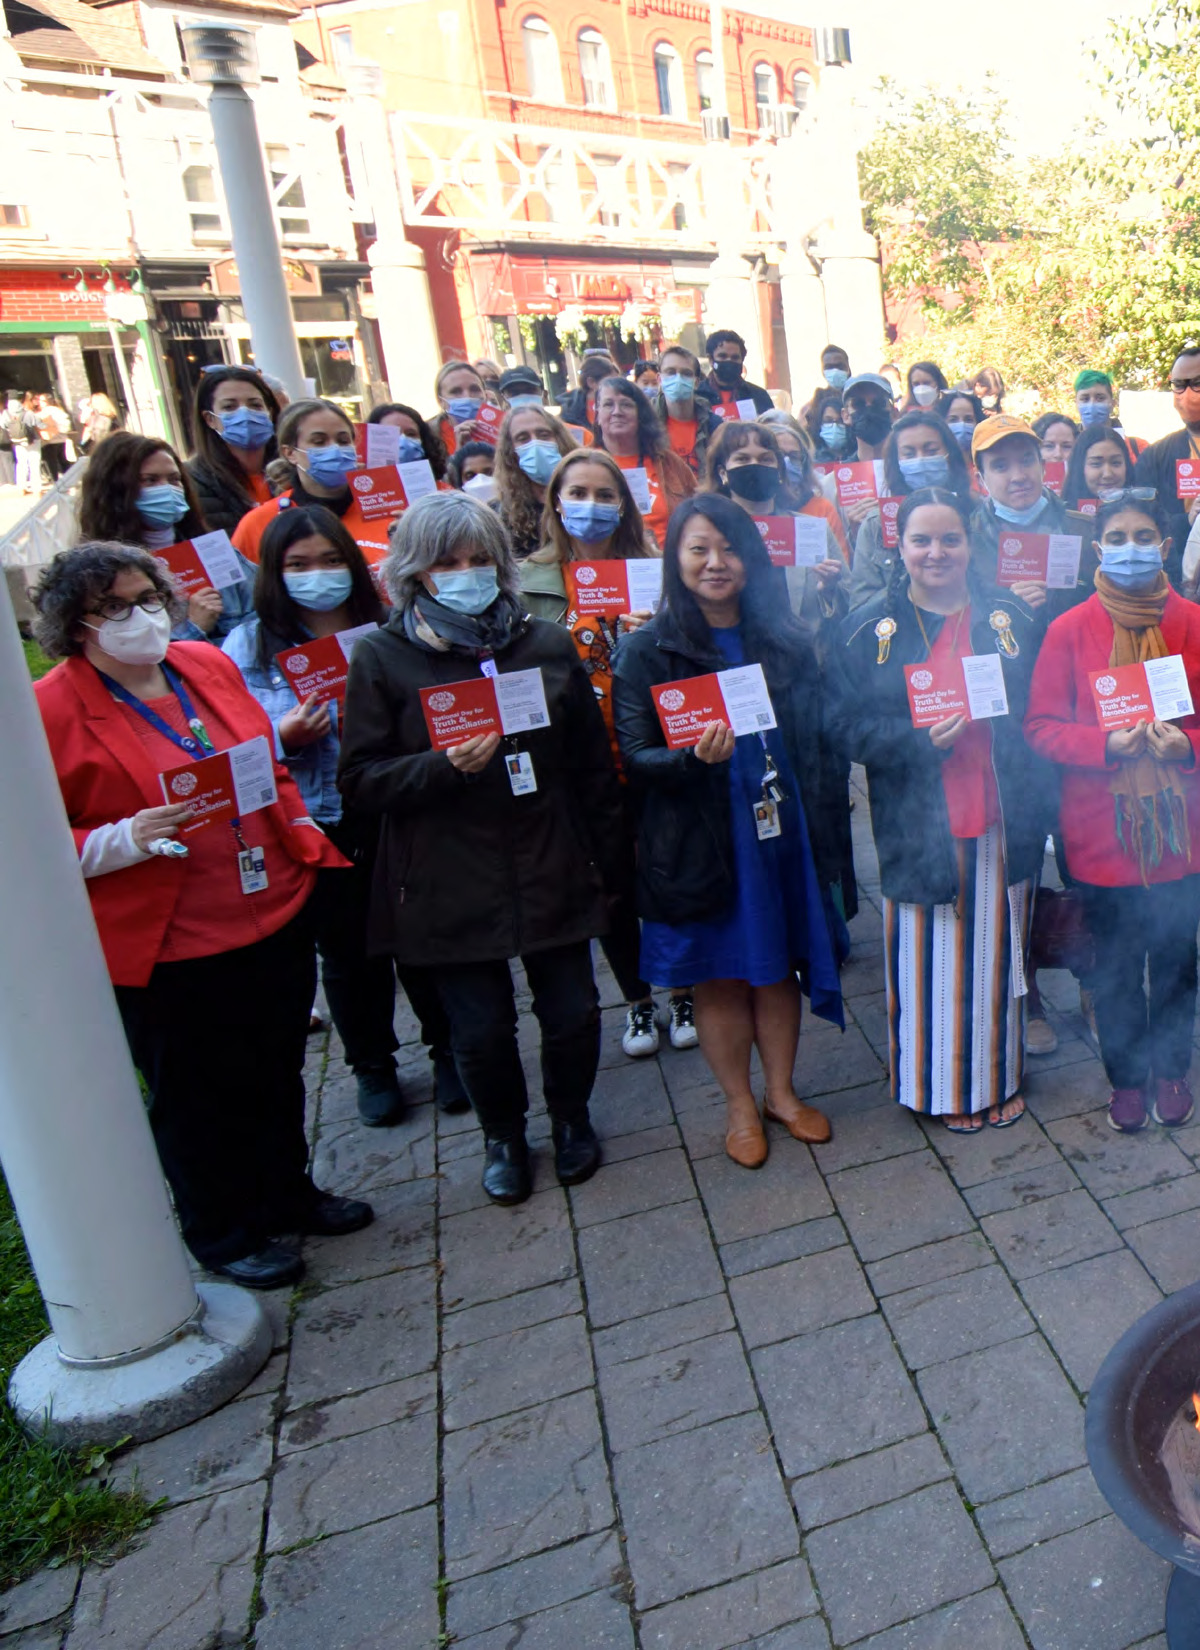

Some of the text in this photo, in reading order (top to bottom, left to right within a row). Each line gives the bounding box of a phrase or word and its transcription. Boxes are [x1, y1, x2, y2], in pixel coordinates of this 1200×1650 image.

[360, 498, 377, 506] Truth
[361, 500, 404, 512] Reconciliation
[294, 672, 316, 684] National
[316, 668, 327, 676] Day
[296, 679, 315, 690] Truth
[300, 675, 348, 696] Reconciliation
[913, 692, 936, 700] National
[936, 690, 948, 698] Day
[1098, 696, 1120, 706] National
[914, 698, 934, 706] Truth
[915, 701, 964, 714] Reconciliation
[1101, 700, 1127, 712] Truth &
[432, 712, 460, 722] National
[460, 710, 473, 718] Day
[664, 711, 691, 722] National
[691, 708, 702, 717] Day
[1102, 704, 1148, 718] Reconciliation
[433, 720, 457, 730] Truth
[435, 718, 495, 736] Reconciliation
[666, 719, 688, 729] Truth
[200, 791, 212, 799] Day
